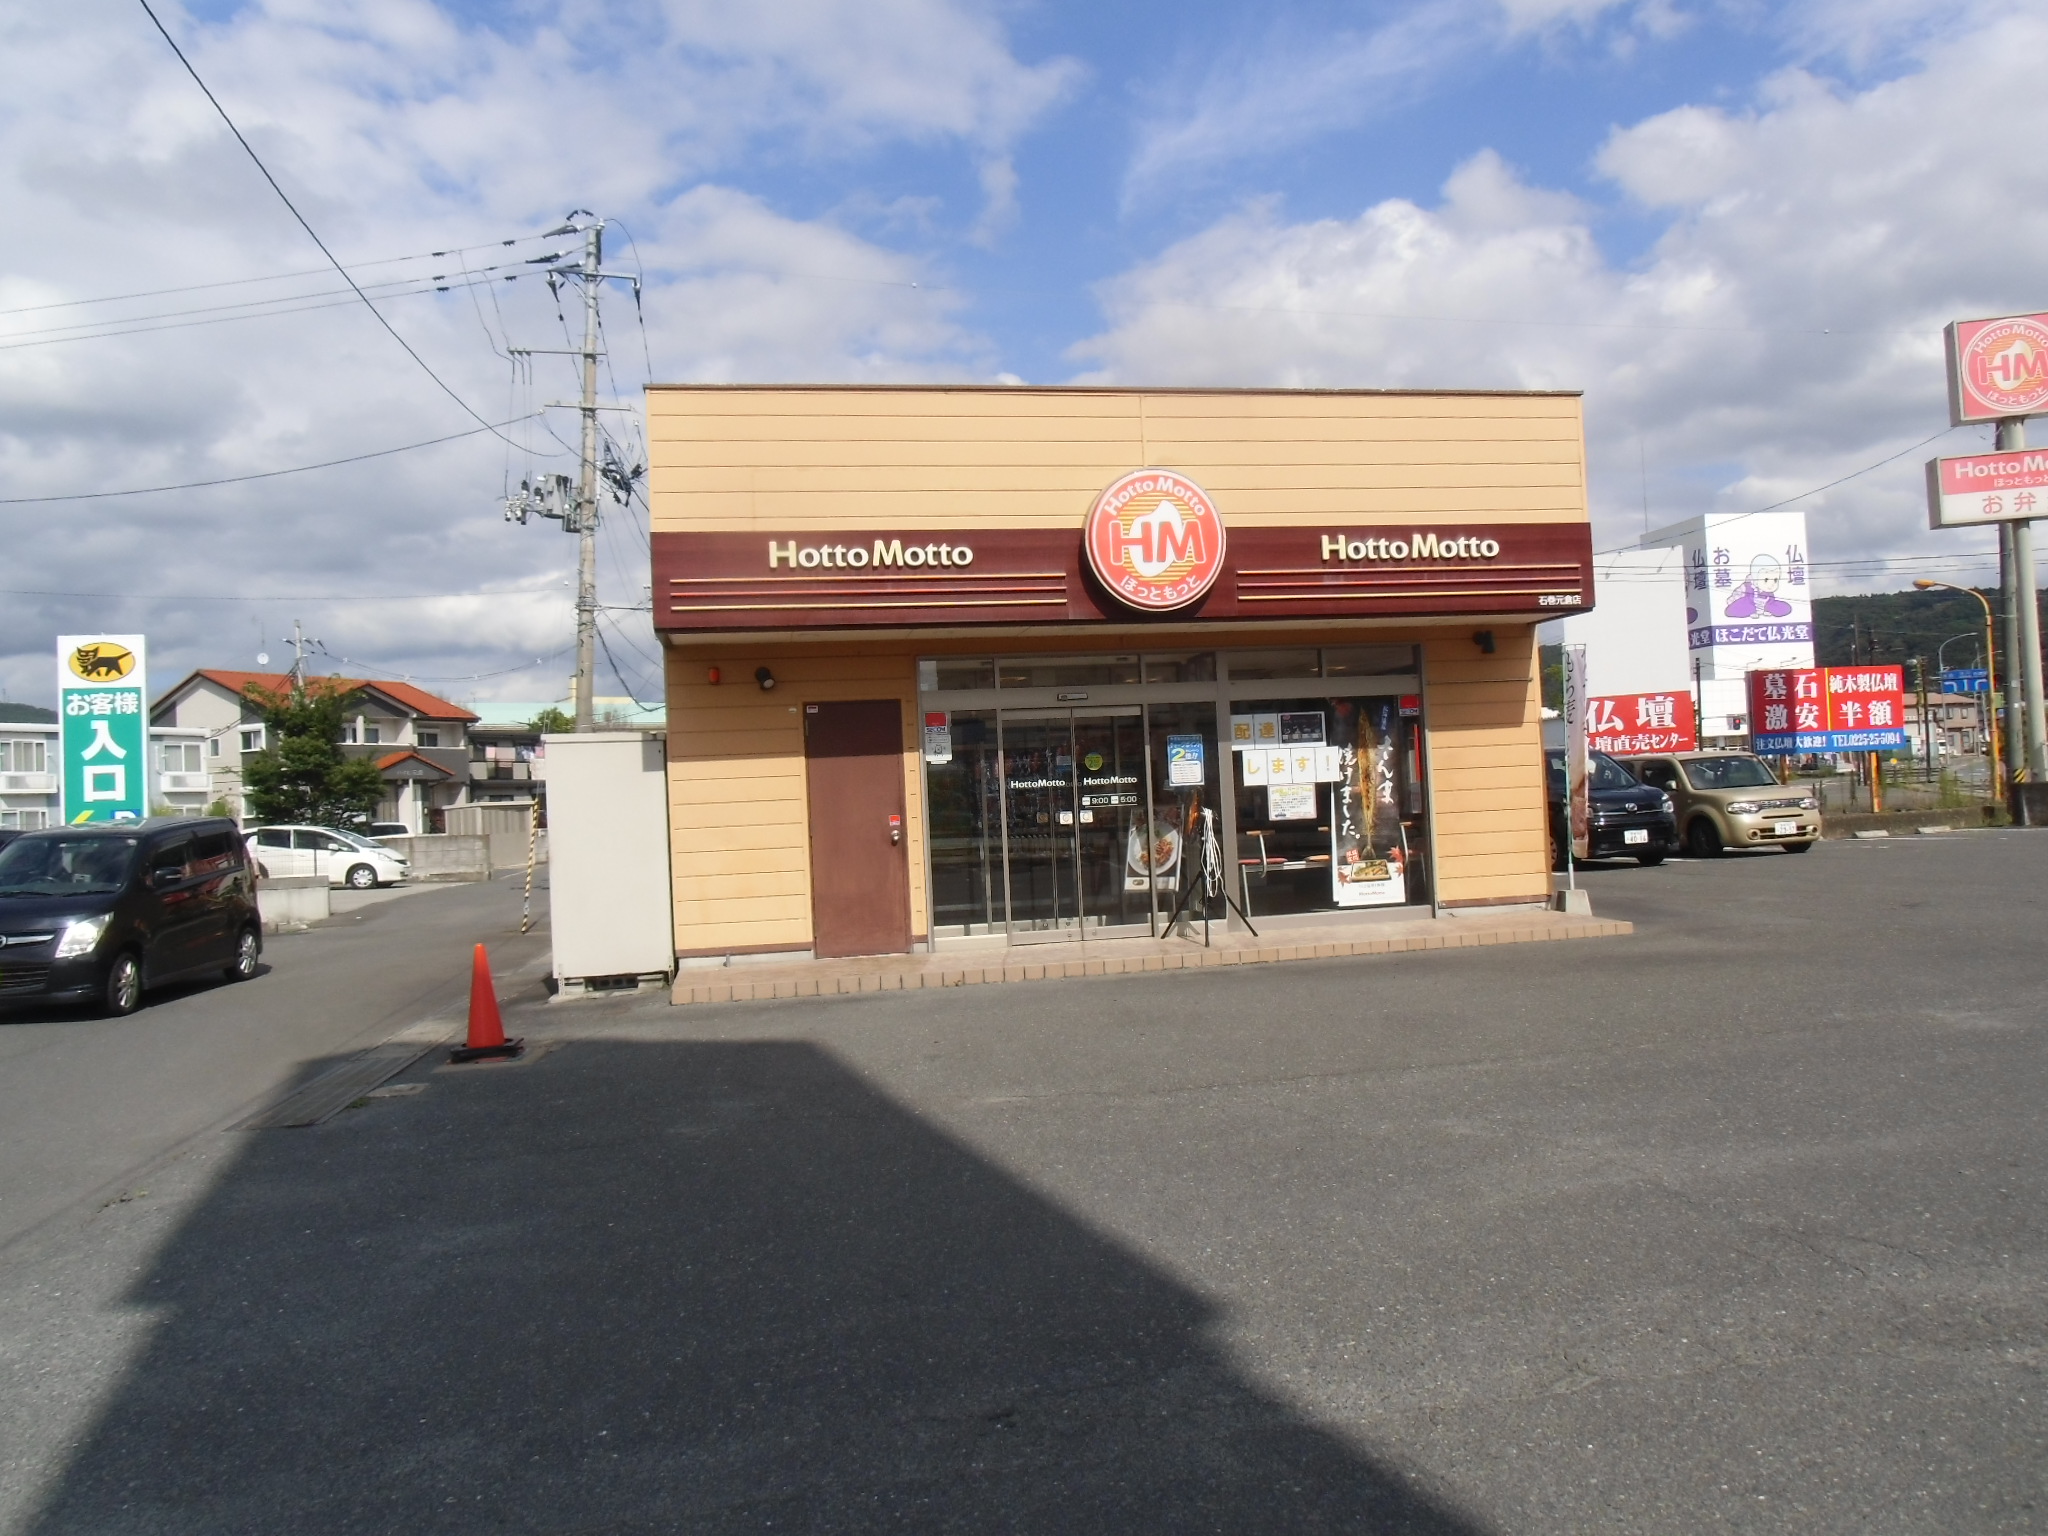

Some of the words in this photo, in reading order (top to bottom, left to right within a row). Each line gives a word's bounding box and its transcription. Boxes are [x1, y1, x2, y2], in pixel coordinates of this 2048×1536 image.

[1987, 386, 2048, 404] ほっともっと
[1955, 455, 2048, 478] HottoM
[1109, 520, 1207, 565] HM
[1713, 546, 1732, 588] お墓
[1785, 544, 1806, 586] 仏壇
[1120, 575, 1200, 600] ほっともっと
[1715, 624, 1810, 643] ほこだて仏光堂
[1763, 672, 1818, 700] 墓石
[66, 692, 139, 716] お客様
[1585, 695, 1677, 733] 仏壇
[1765, 702, 1820, 730] 激安
[1839, 699, 1893, 727] 半額
[1233, 722, 1276, 741] 配達
[80, 719, 127, 803] 入口
[1377, 734, 1394, 805] さんま
